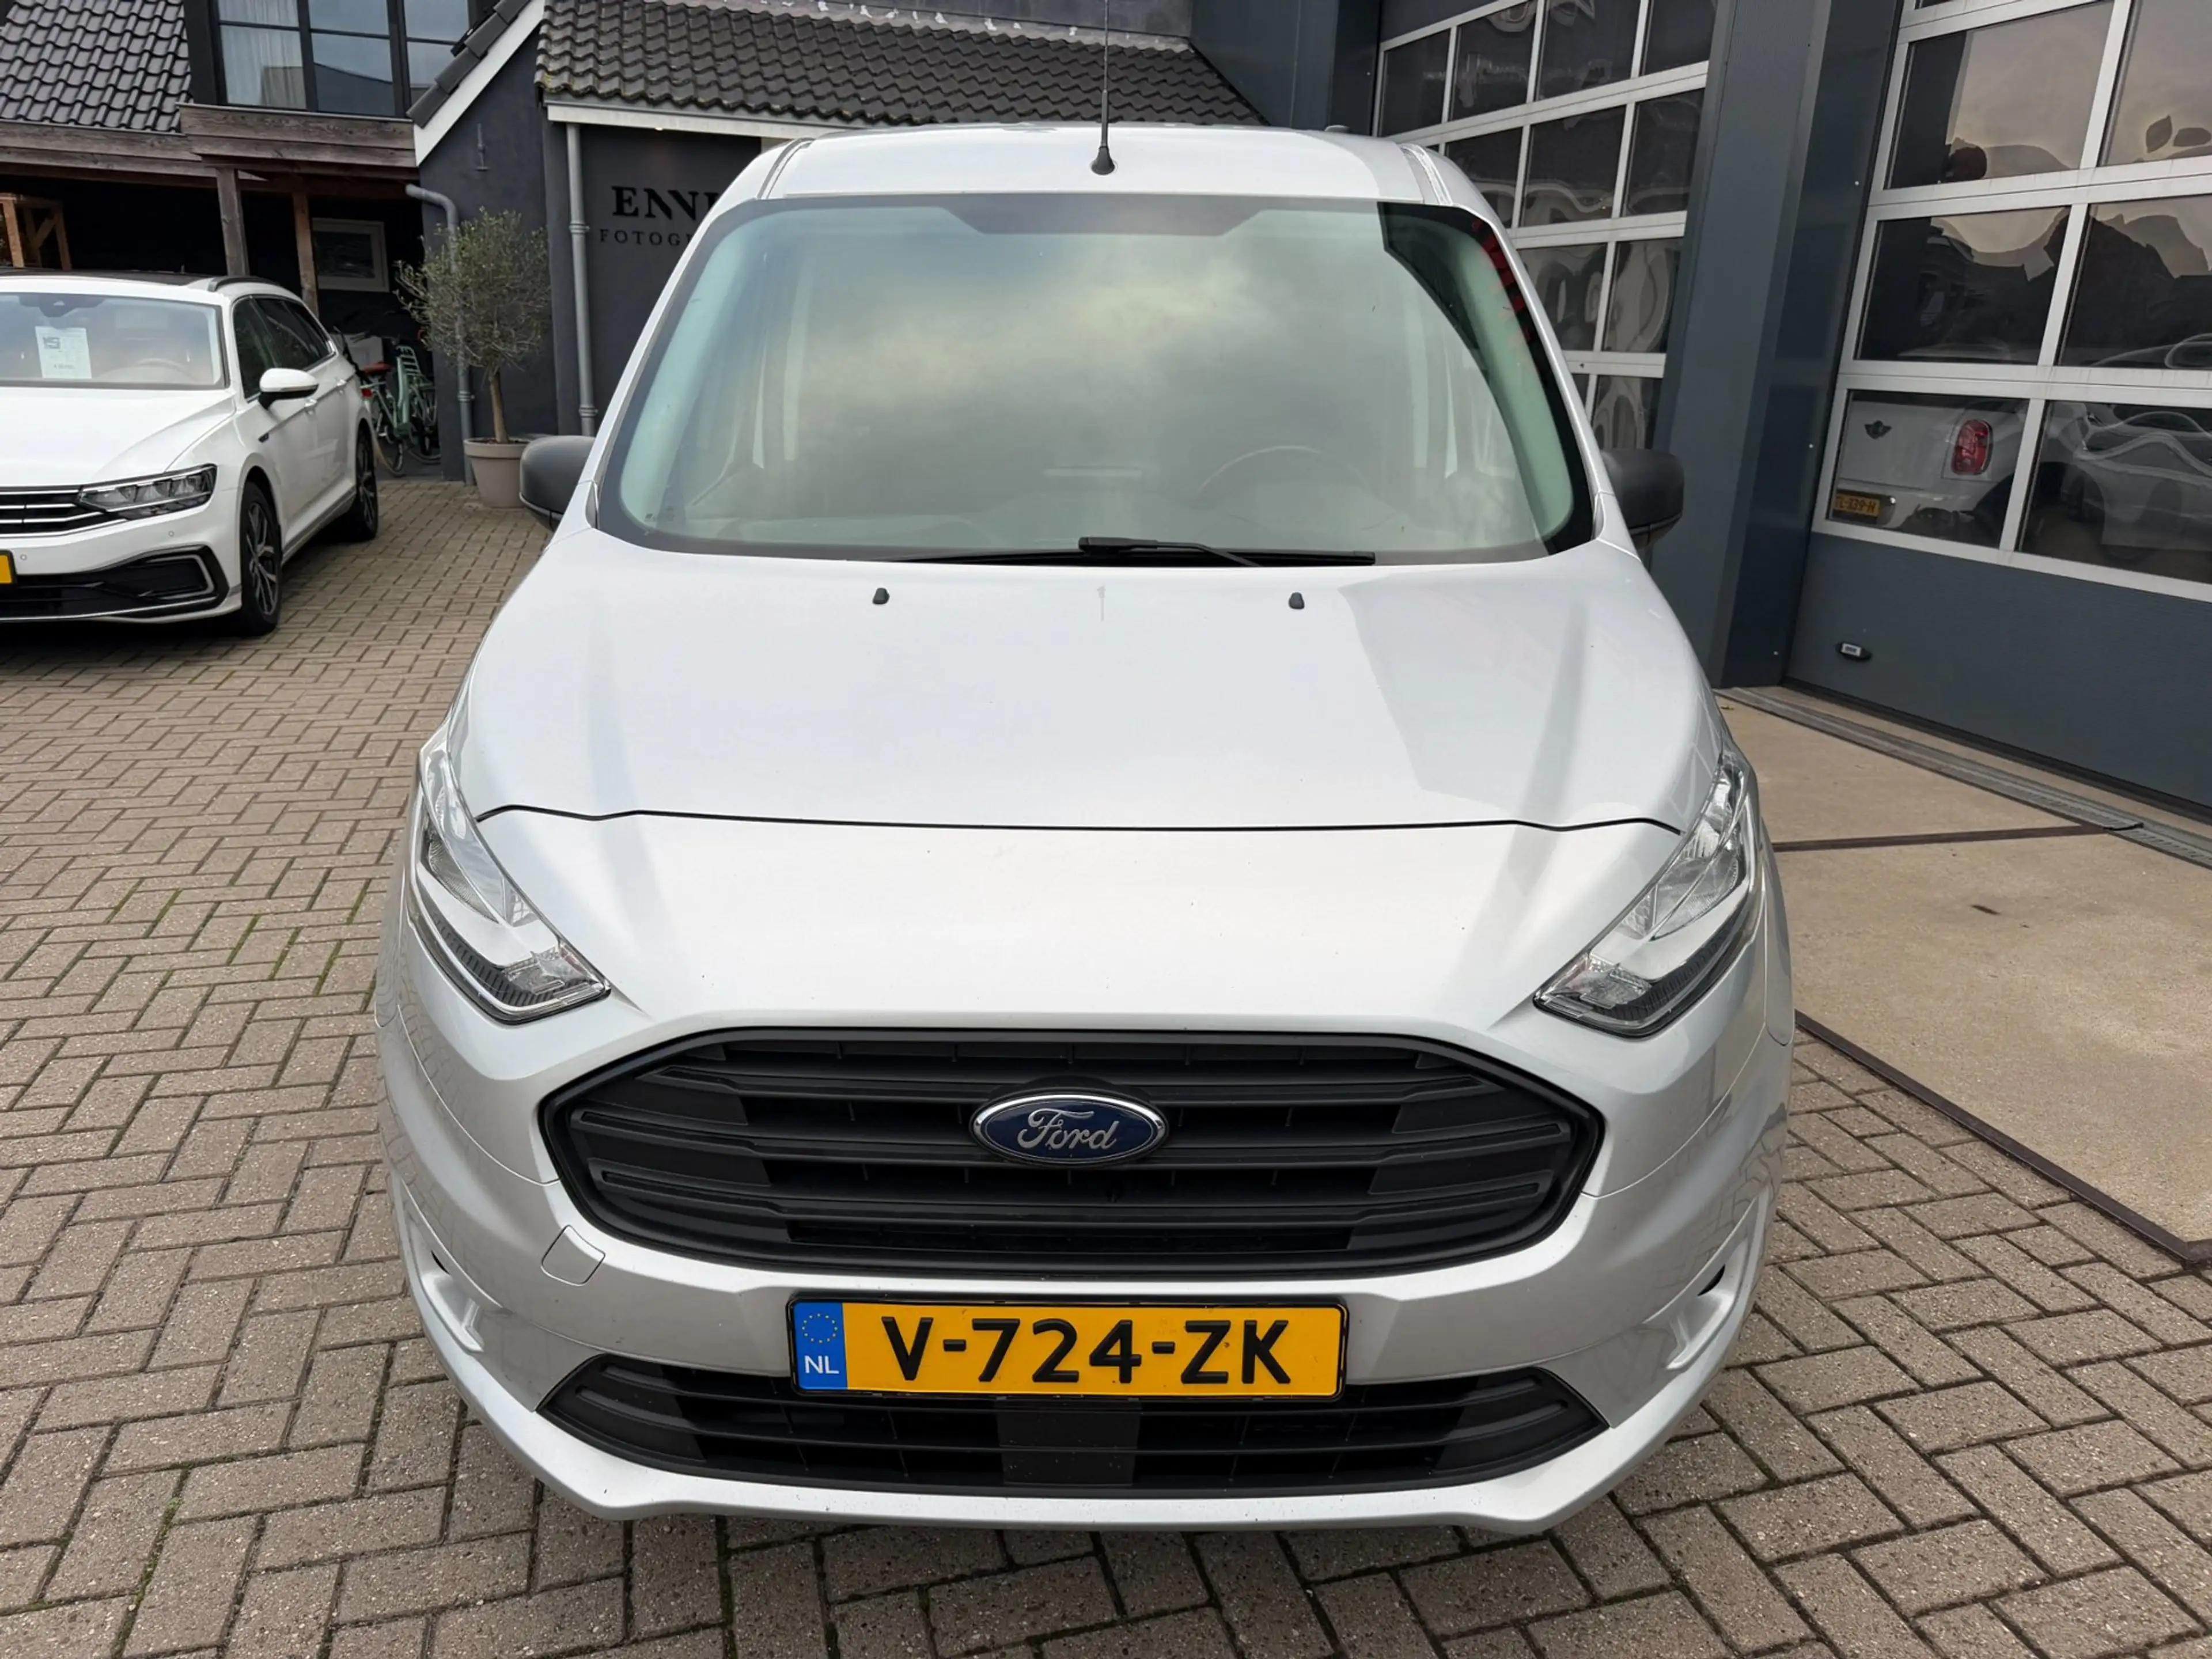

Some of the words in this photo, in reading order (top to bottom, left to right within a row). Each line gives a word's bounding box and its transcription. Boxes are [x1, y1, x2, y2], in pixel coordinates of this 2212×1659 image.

[1017, 1108, 1119, 1150] Ford
[804, 1355, 839, 1374] NL
[881, 1316, 1291, 1385] V-724-ZK
